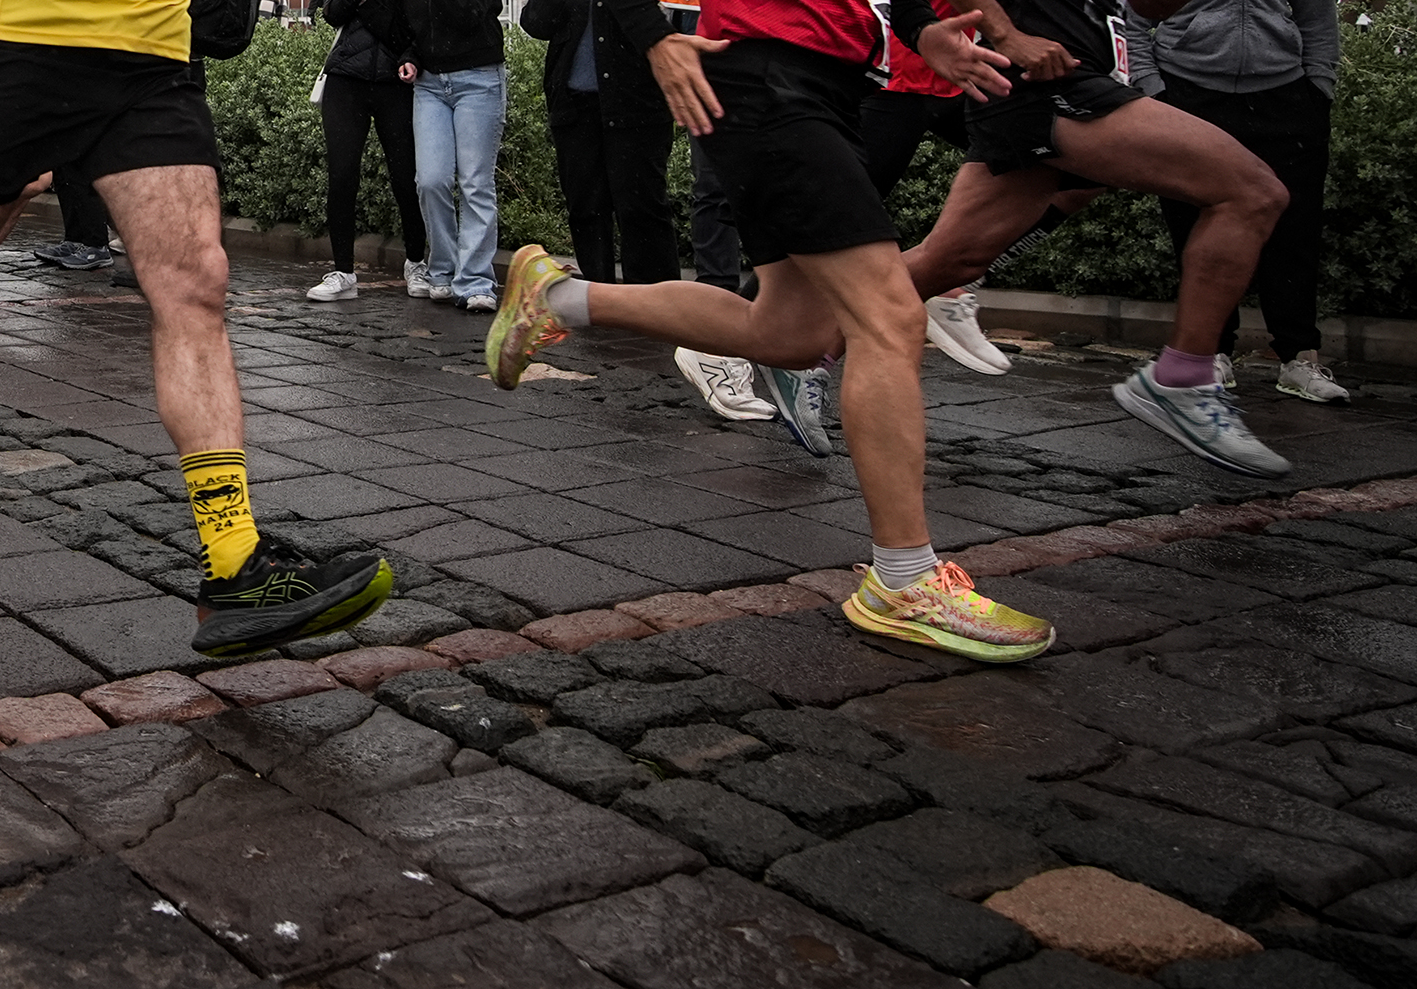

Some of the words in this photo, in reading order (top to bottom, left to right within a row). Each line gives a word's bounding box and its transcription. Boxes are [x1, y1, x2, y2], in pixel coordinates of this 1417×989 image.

[187, 474, 240, 489] BLACK
[198, 509, 251, 528] MAMBA
[214, 520, 234, 532] 24
